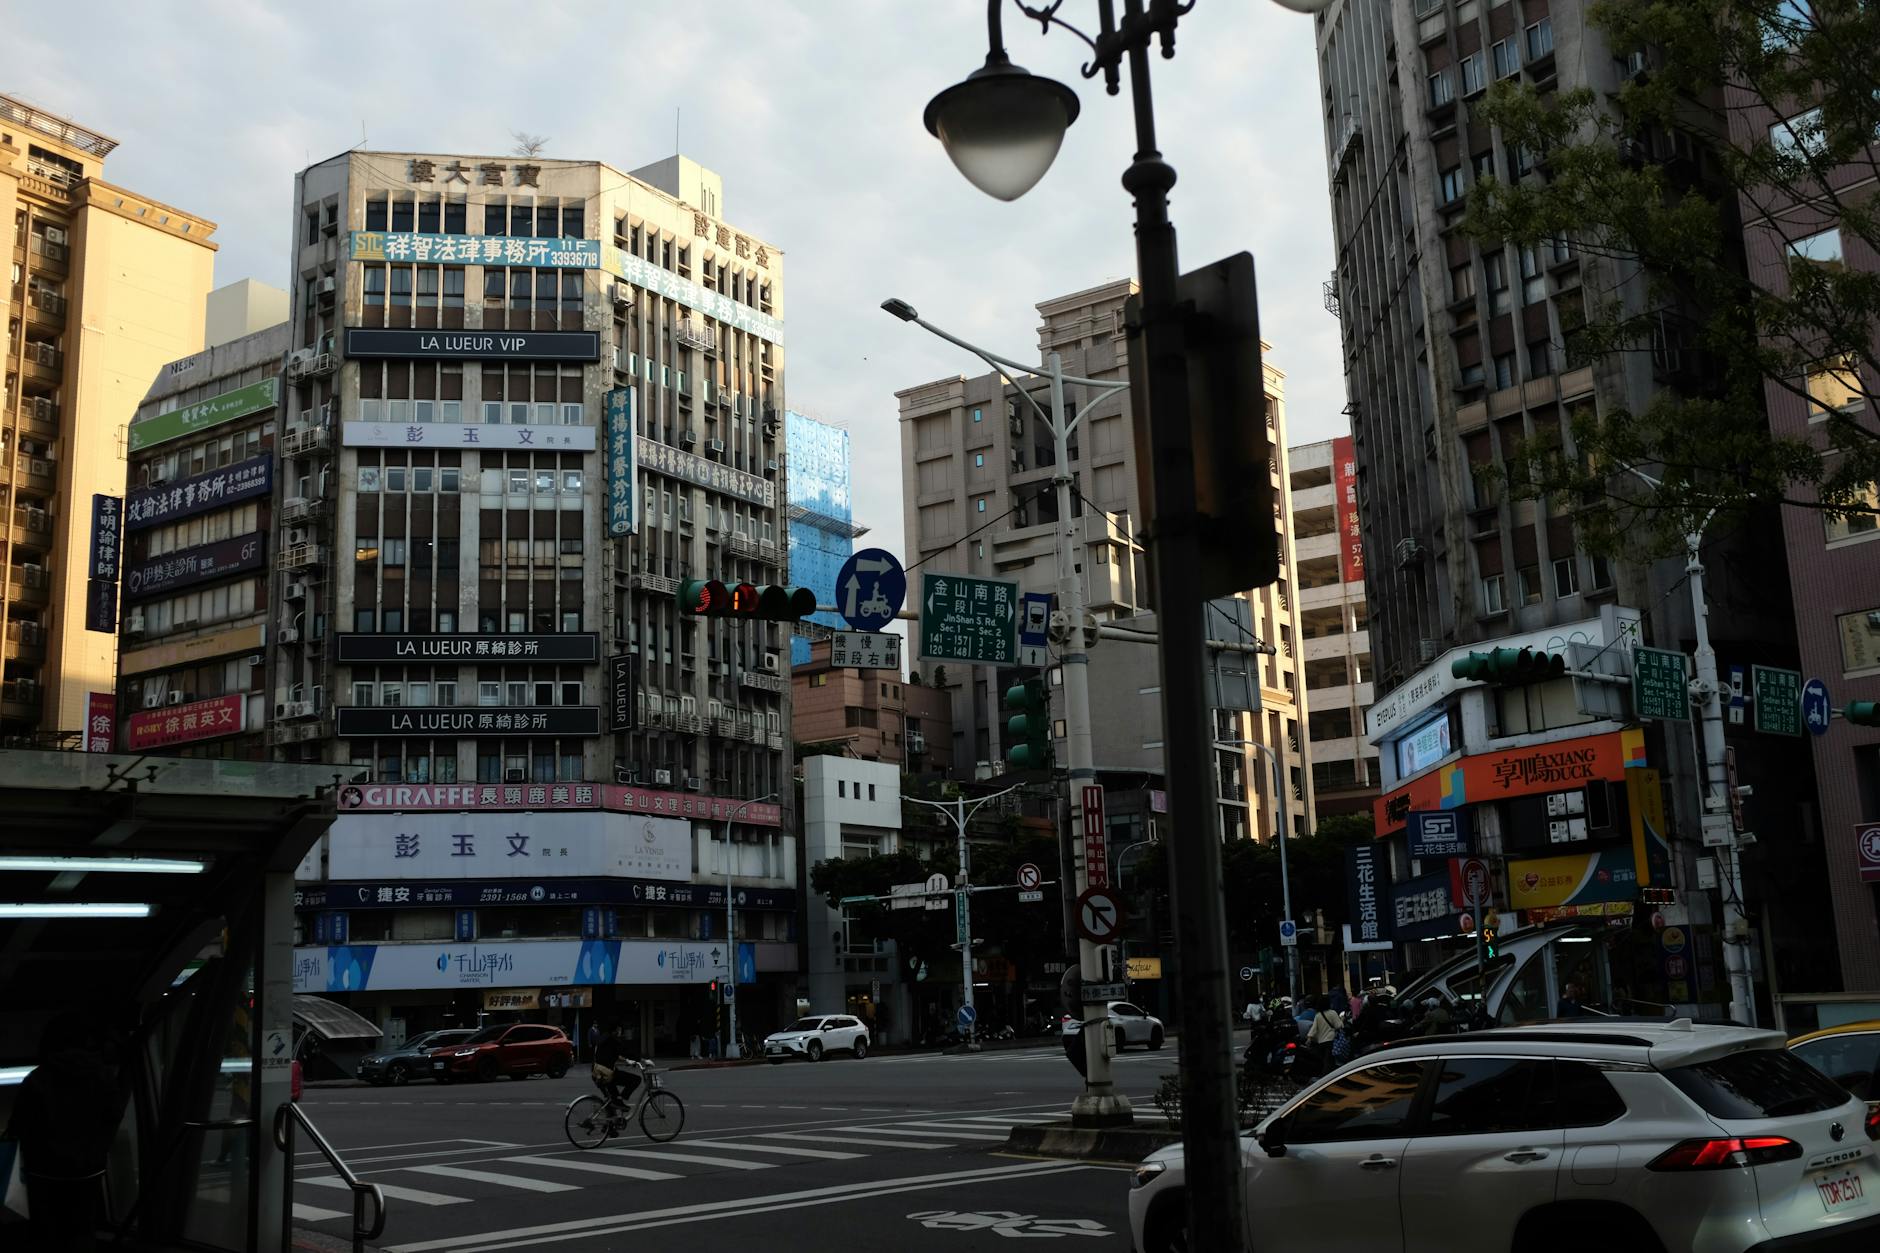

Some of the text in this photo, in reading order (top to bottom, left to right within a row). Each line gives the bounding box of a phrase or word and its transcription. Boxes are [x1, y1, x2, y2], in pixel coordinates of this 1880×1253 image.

[386, 234, 550, 264] 祥智法律事務所
[551, 251, 597, 266] 33936718
[624, 255, 750, 329] 祥智法律事務所
[420, 336, 527, 351] LA LUEUR VIP
[406, 426, 534, 445] 彭玉文
[240, 541, 257, 561] 6F
[934, 579, 1008, 603] 金山南路
[943, 613, 974, 625] JinShan
[396, 641, 416, 655] LA
[422, 641, 472, 656] LUEUR
[834, 634, 897, 651] 機慢車
[833, 650, 896, 667] 兩段右轉
[1638, 651, 1681, 670] 金山南路
[615, 662, 627, 723] LA LUEUR
[165, 707, 234, 735] 徐薇英文
[391, 713, 414, 730] LA
[419, 713, 474, 730] LUEUR
[1549, 748, 1595, 768] XIANG
[1550, 764, 1594, 783] DUCK
[366, 787, 476, 806] GIRAFFE
[479, 786, 593, 806] 長頸鹿美語
[1424, 818, 1452, 834] SF
[395, 832, 530, 859] 彭玉文
[542, 848, 568, 857] 院長
[1414, 842, 1467, 856] 三花生活館
[377, 887, 410, 903] 捷安
[416, 892, 453, 902] 牙醫診所
[480, 893, 528, 902] 2391-1568
[645, 885, 667, 901] 捷安
[1356, 846, 1379, 940] 三花生活館
[454, 946, 513, 983] 千山淨水
[668, 944, 705, 981] 千山淨水
